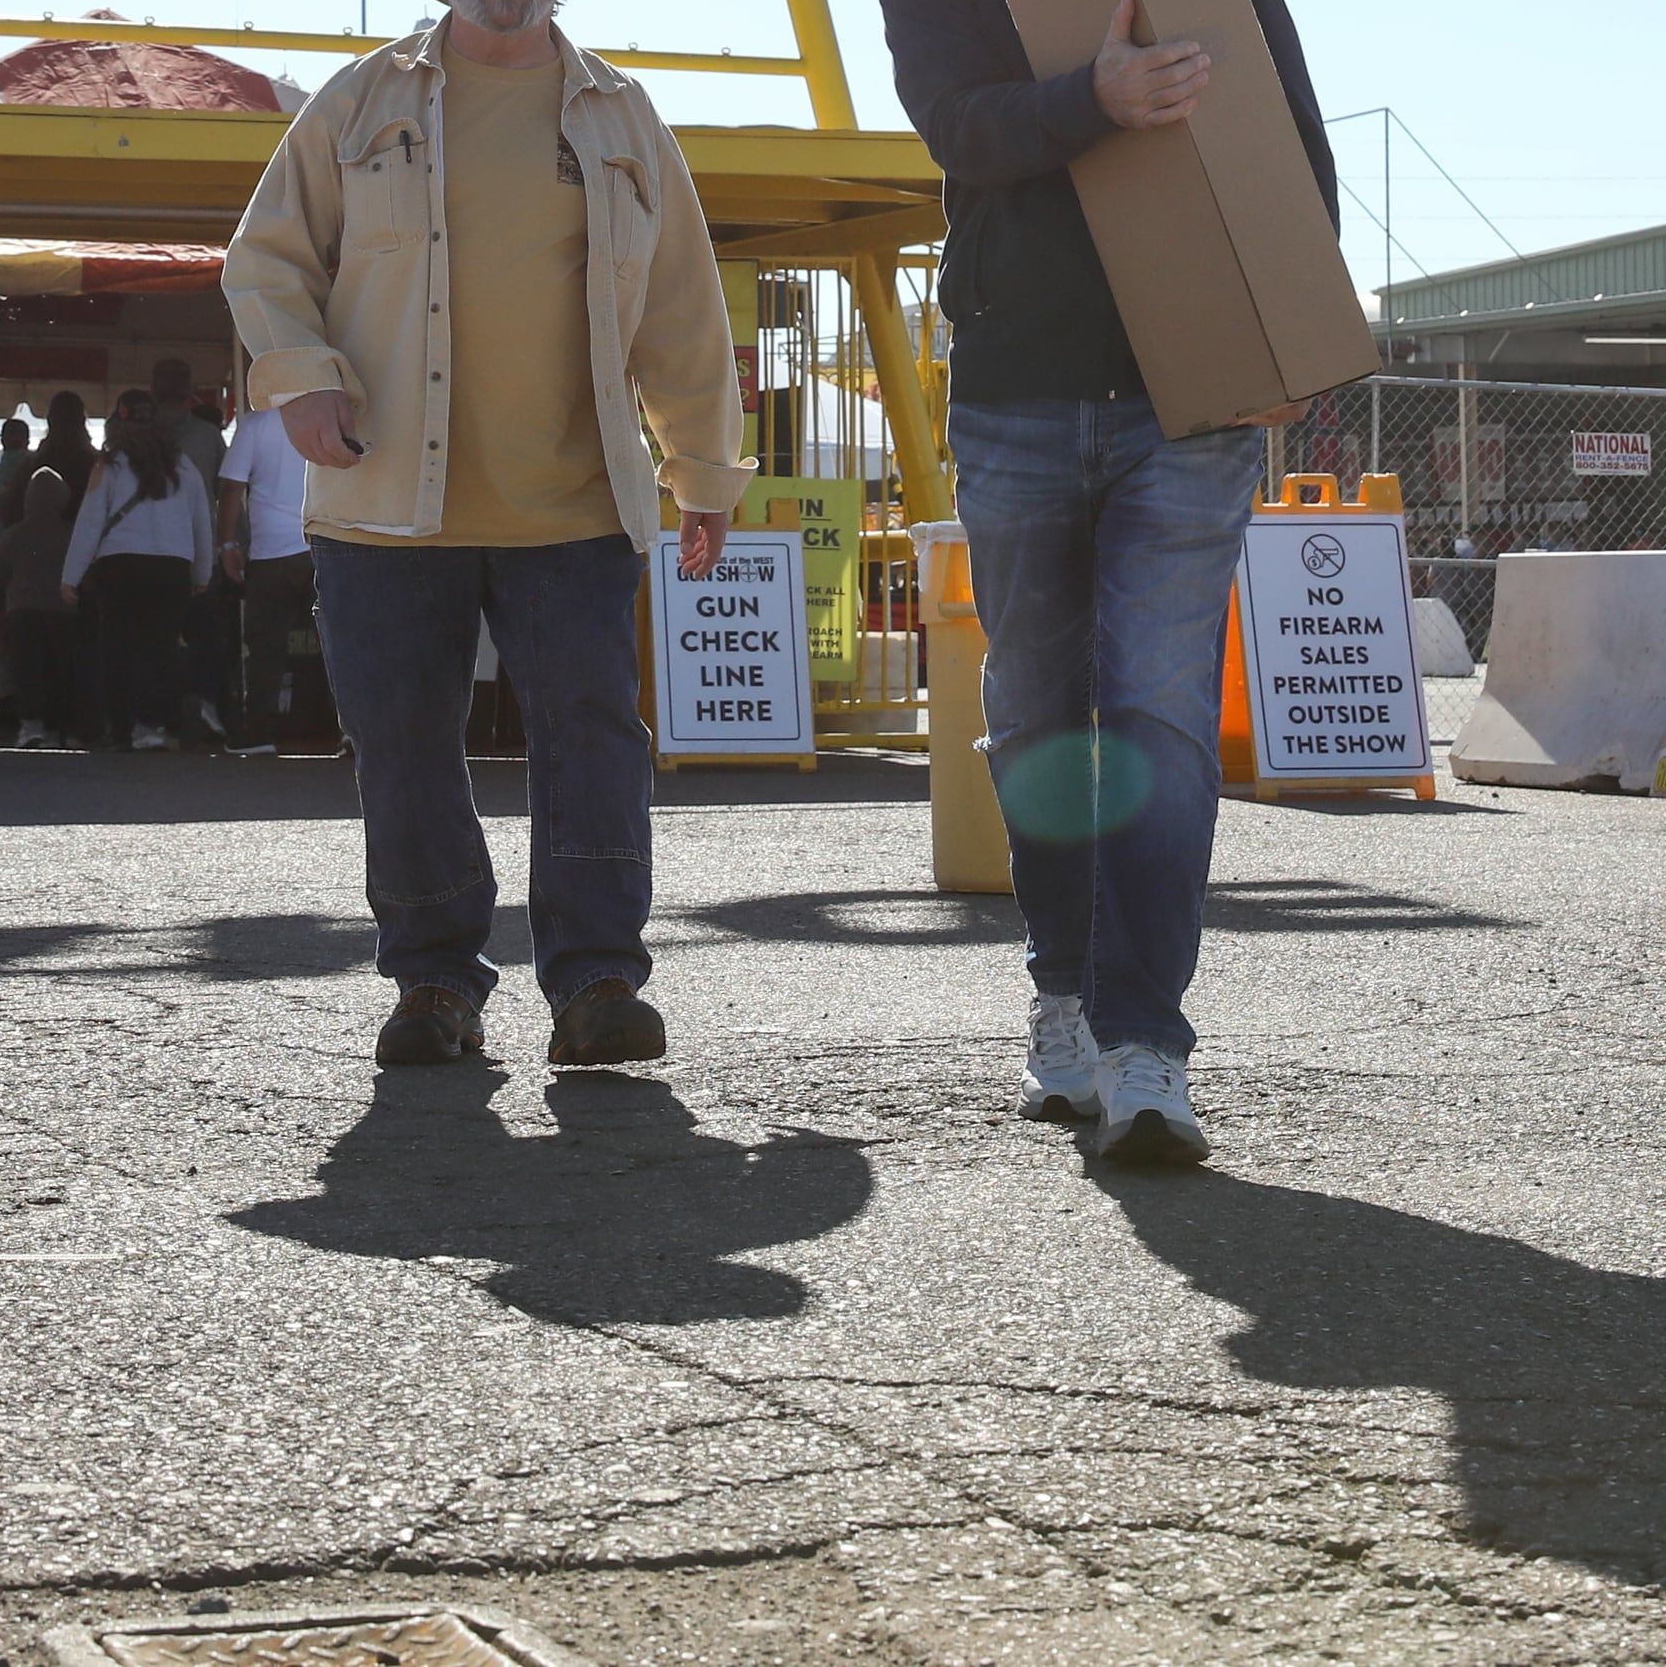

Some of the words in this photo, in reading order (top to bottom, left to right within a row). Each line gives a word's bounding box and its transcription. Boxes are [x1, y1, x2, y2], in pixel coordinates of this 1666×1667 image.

[1575, 435, 1648, 454] NATIONAL
[1576, 455, 1648, 463] RENT-A-FENCE
[753, 557, 774, 565] WEST
[1307, 587, 1344, 606] NO
[696, 596, 760, 618] GUN
[1279, 616, 1384, 635] FIREARM
[680, 630, 781, 652] CHECK
[1300, 646, 1369, 665] SALES
[700, 665, 764, 687] LINE
[1273, 675, 1403, 695] PERMITTED
[696, 700, 773, 722] HERE
[1288, 705, 1390, 724] OUTSIDE
[1283, 735, 1329, 754] THE
[1336, 734, 1406, 754] SHOW
